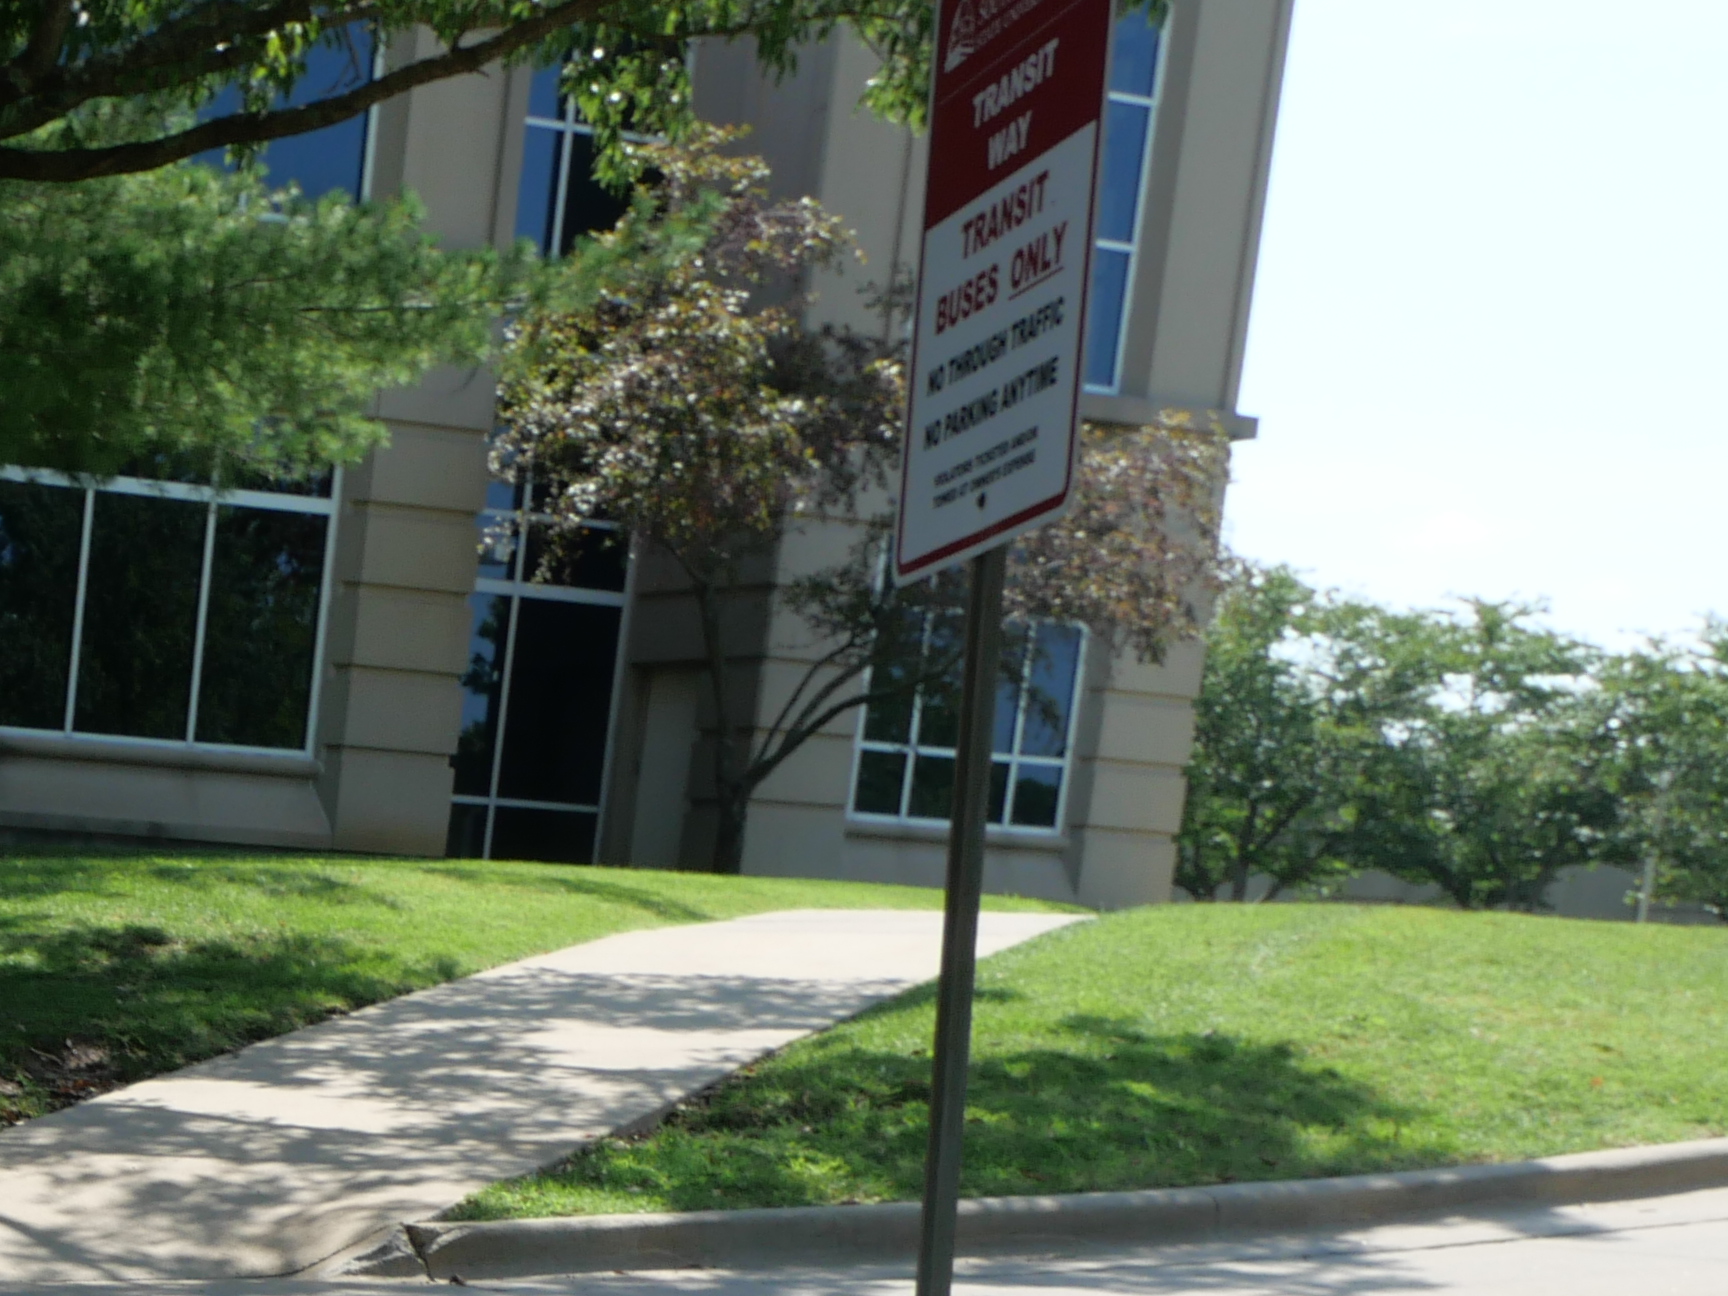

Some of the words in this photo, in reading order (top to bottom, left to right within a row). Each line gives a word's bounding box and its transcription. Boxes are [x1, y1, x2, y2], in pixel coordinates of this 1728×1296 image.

[972, 37, 1060, 129] TRANSIT
[988, 110, 1033, 170] WAY
[961, 169, 1050, 260] TRANSIT
[935, 263, 1000, 336] BUSES
[1010, 220, 1069, 290] ONLY
[926, 364, 945, 397] NO
[948, 328, 1009, 385] THROUGH
[1011, 296, 1065, 350] TRAFFIC
[923, 418, 942, 451] NO
[944, 388, 998, 441] PARKING
[1000, 355, 1060, 413] ANYTIME
